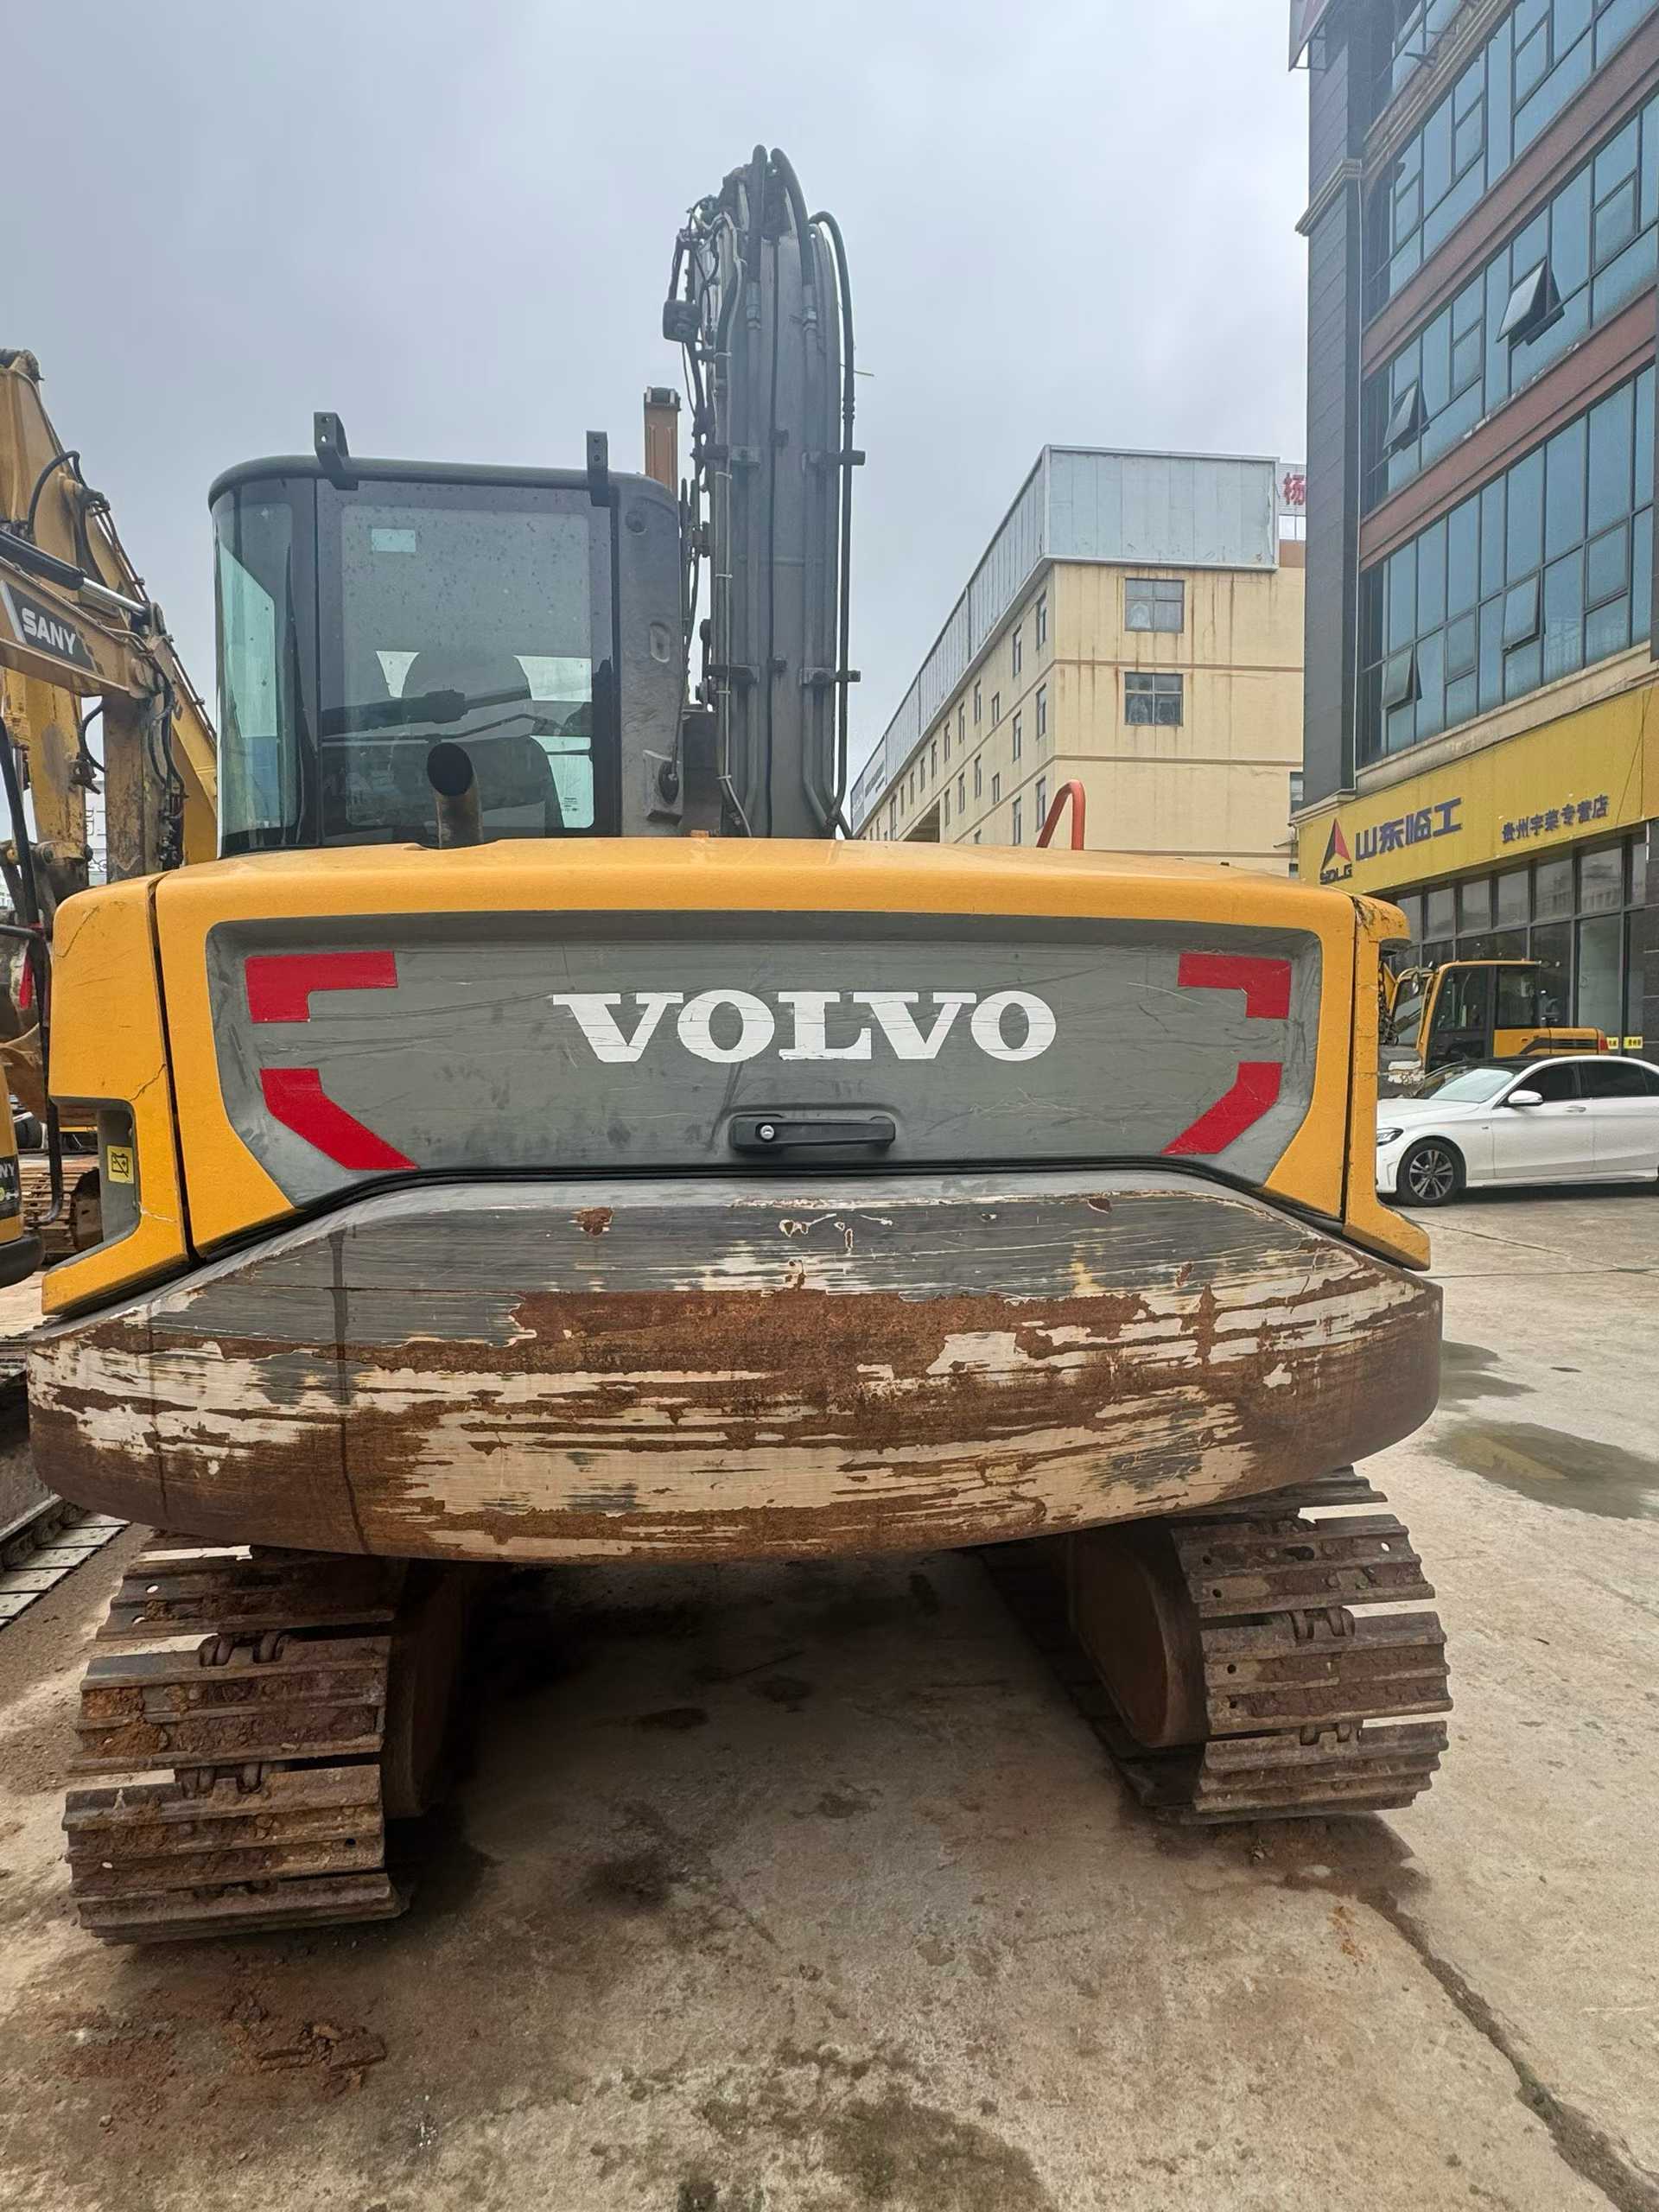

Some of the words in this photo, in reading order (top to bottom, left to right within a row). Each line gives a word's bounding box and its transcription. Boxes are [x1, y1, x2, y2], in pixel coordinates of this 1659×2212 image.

[22, 607, 76, 655] SANY
[1355, 798, 1462, 861] 山东临工
[1320, 864, 1353, 885] SDLG
[552, 989, 1057, 1063] VOLVO
